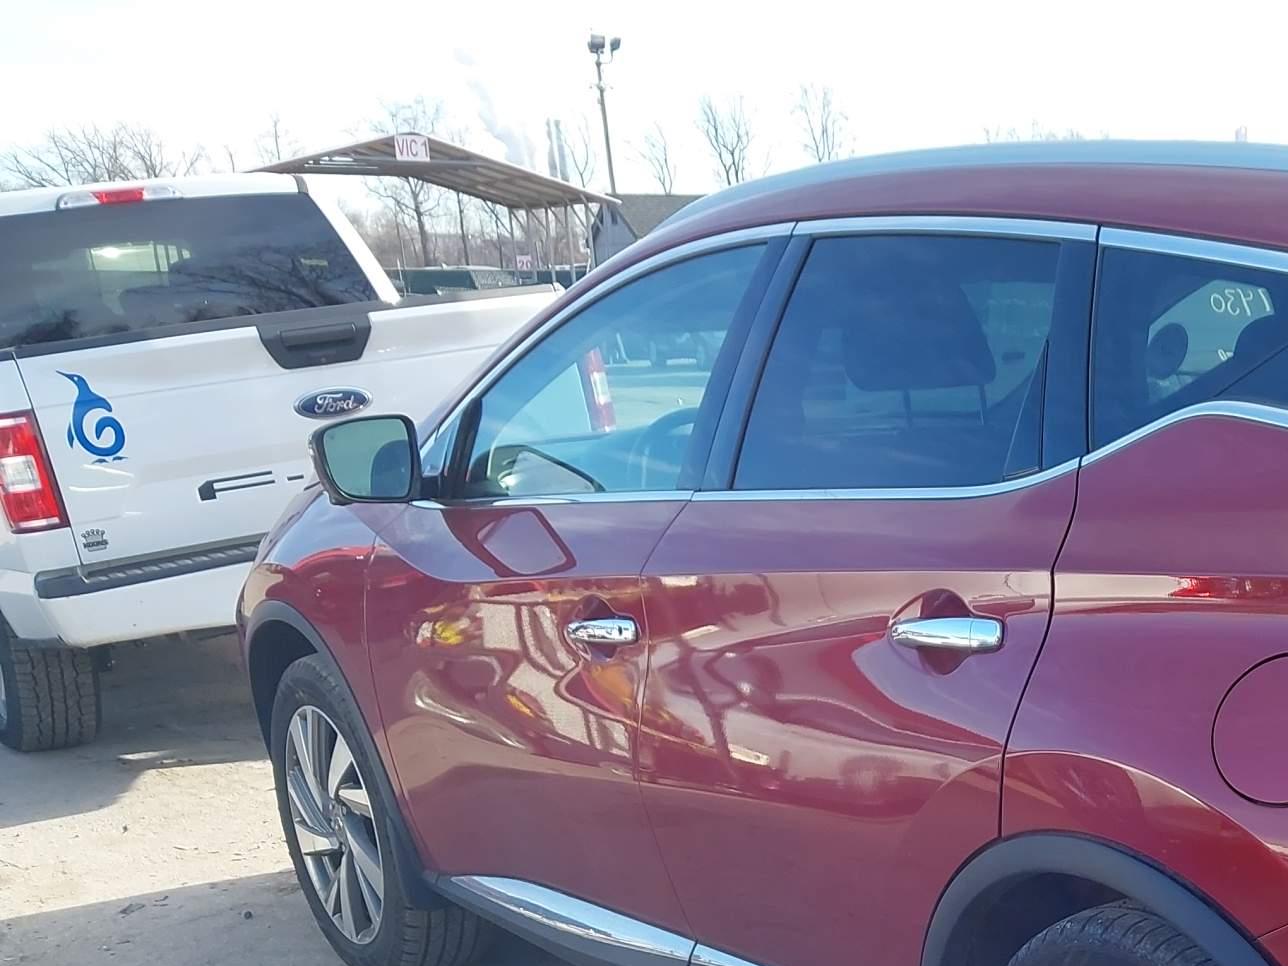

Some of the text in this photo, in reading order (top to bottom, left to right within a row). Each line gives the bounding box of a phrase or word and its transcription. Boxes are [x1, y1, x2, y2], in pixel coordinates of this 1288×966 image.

[395, 137, 429, 158] VIC 1
[313, 392, 357, 414] Ford
